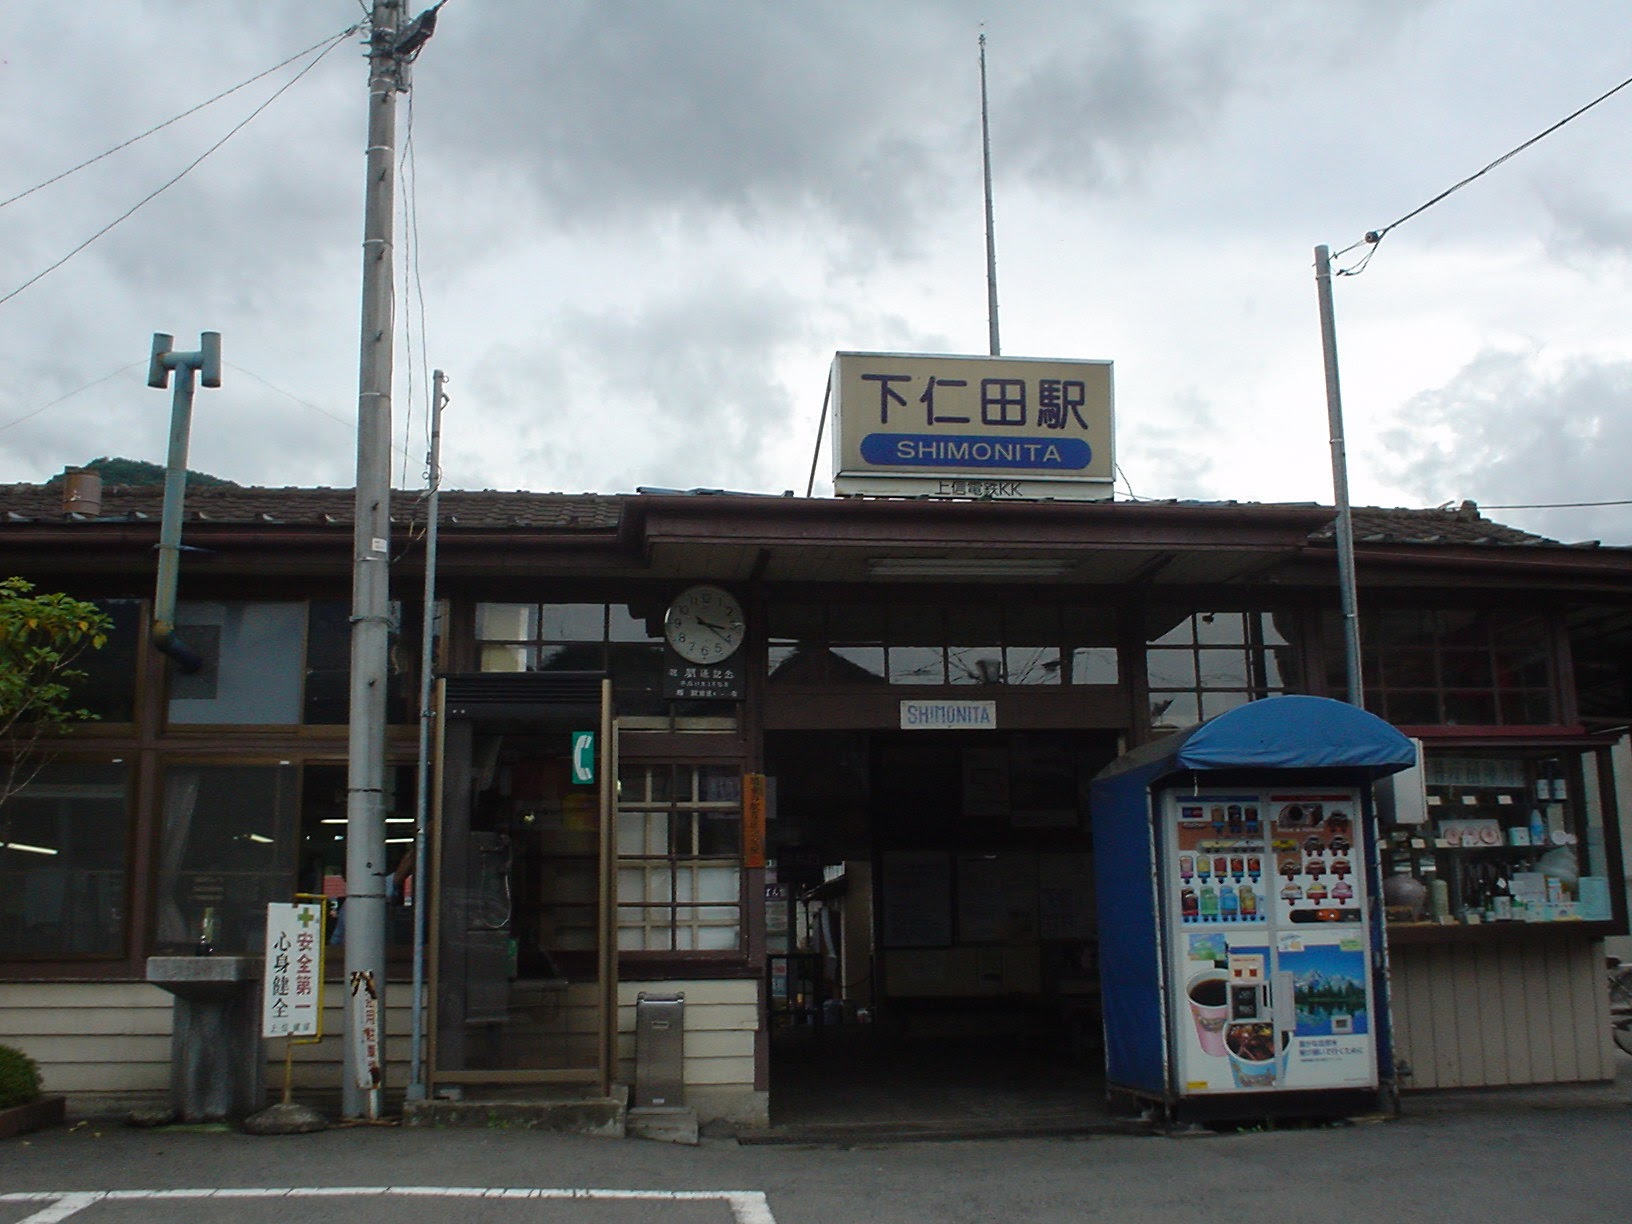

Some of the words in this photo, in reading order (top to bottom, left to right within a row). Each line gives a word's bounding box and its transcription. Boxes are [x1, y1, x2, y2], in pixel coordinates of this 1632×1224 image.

[861, 373, 1089, 430] 下仁田駅
[897, 440, 1062, 463] SHIMONITA
[907, 705, 990, 724] SHIMONITA
[272, 931, 292, 1018] 心身健全
[295, 933, 315, 1008] 安全第一
